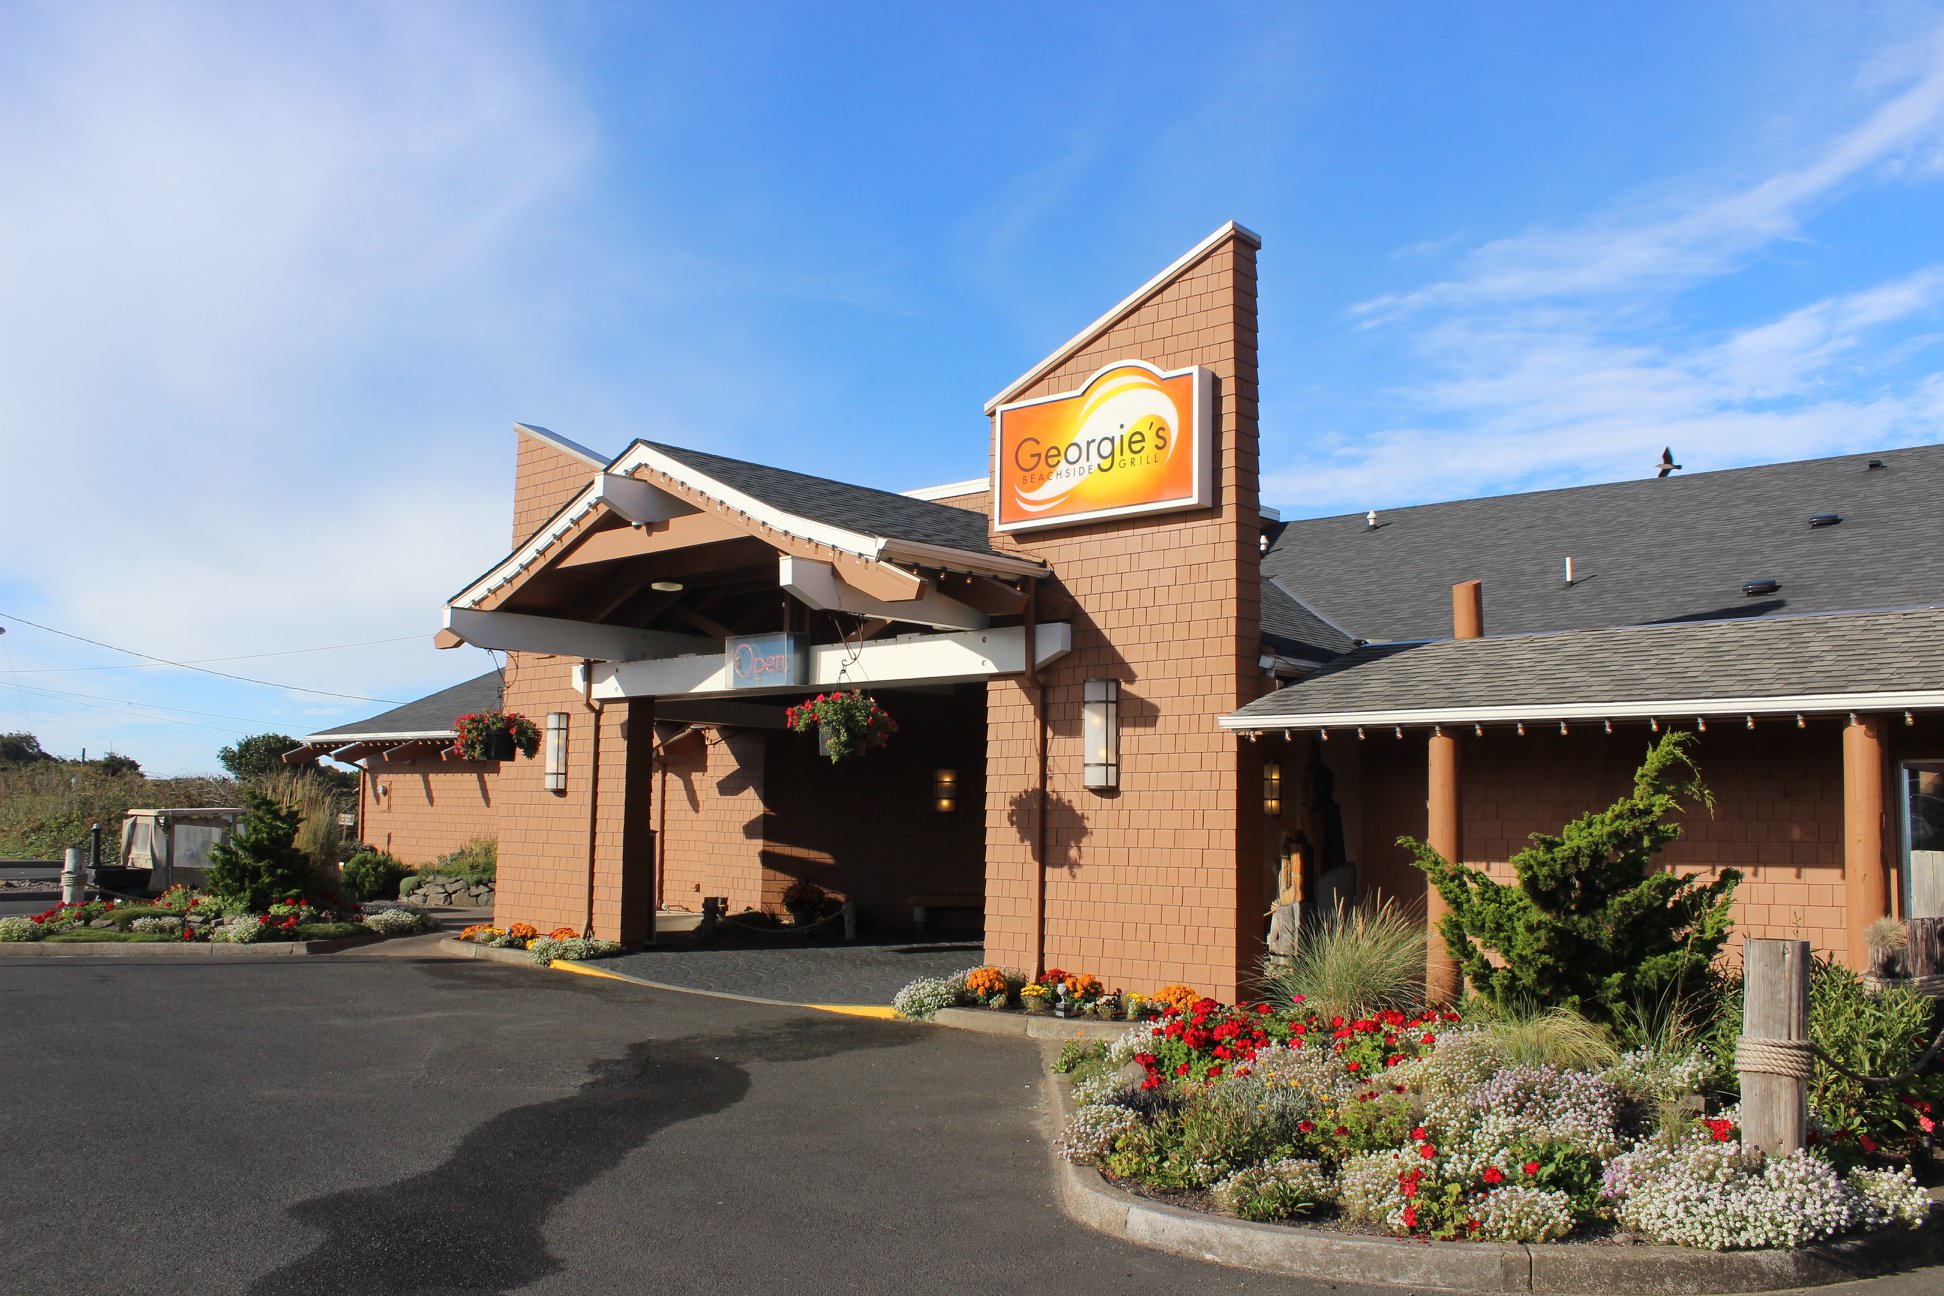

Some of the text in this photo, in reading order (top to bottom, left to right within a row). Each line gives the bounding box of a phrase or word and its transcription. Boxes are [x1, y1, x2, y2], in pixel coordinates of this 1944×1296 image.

[1014, 421, 1168, 473] Georgie's
[1022, 453, 1160, 485] BEACHSIDE GRILL
[734, 643, 785, 681] Open
